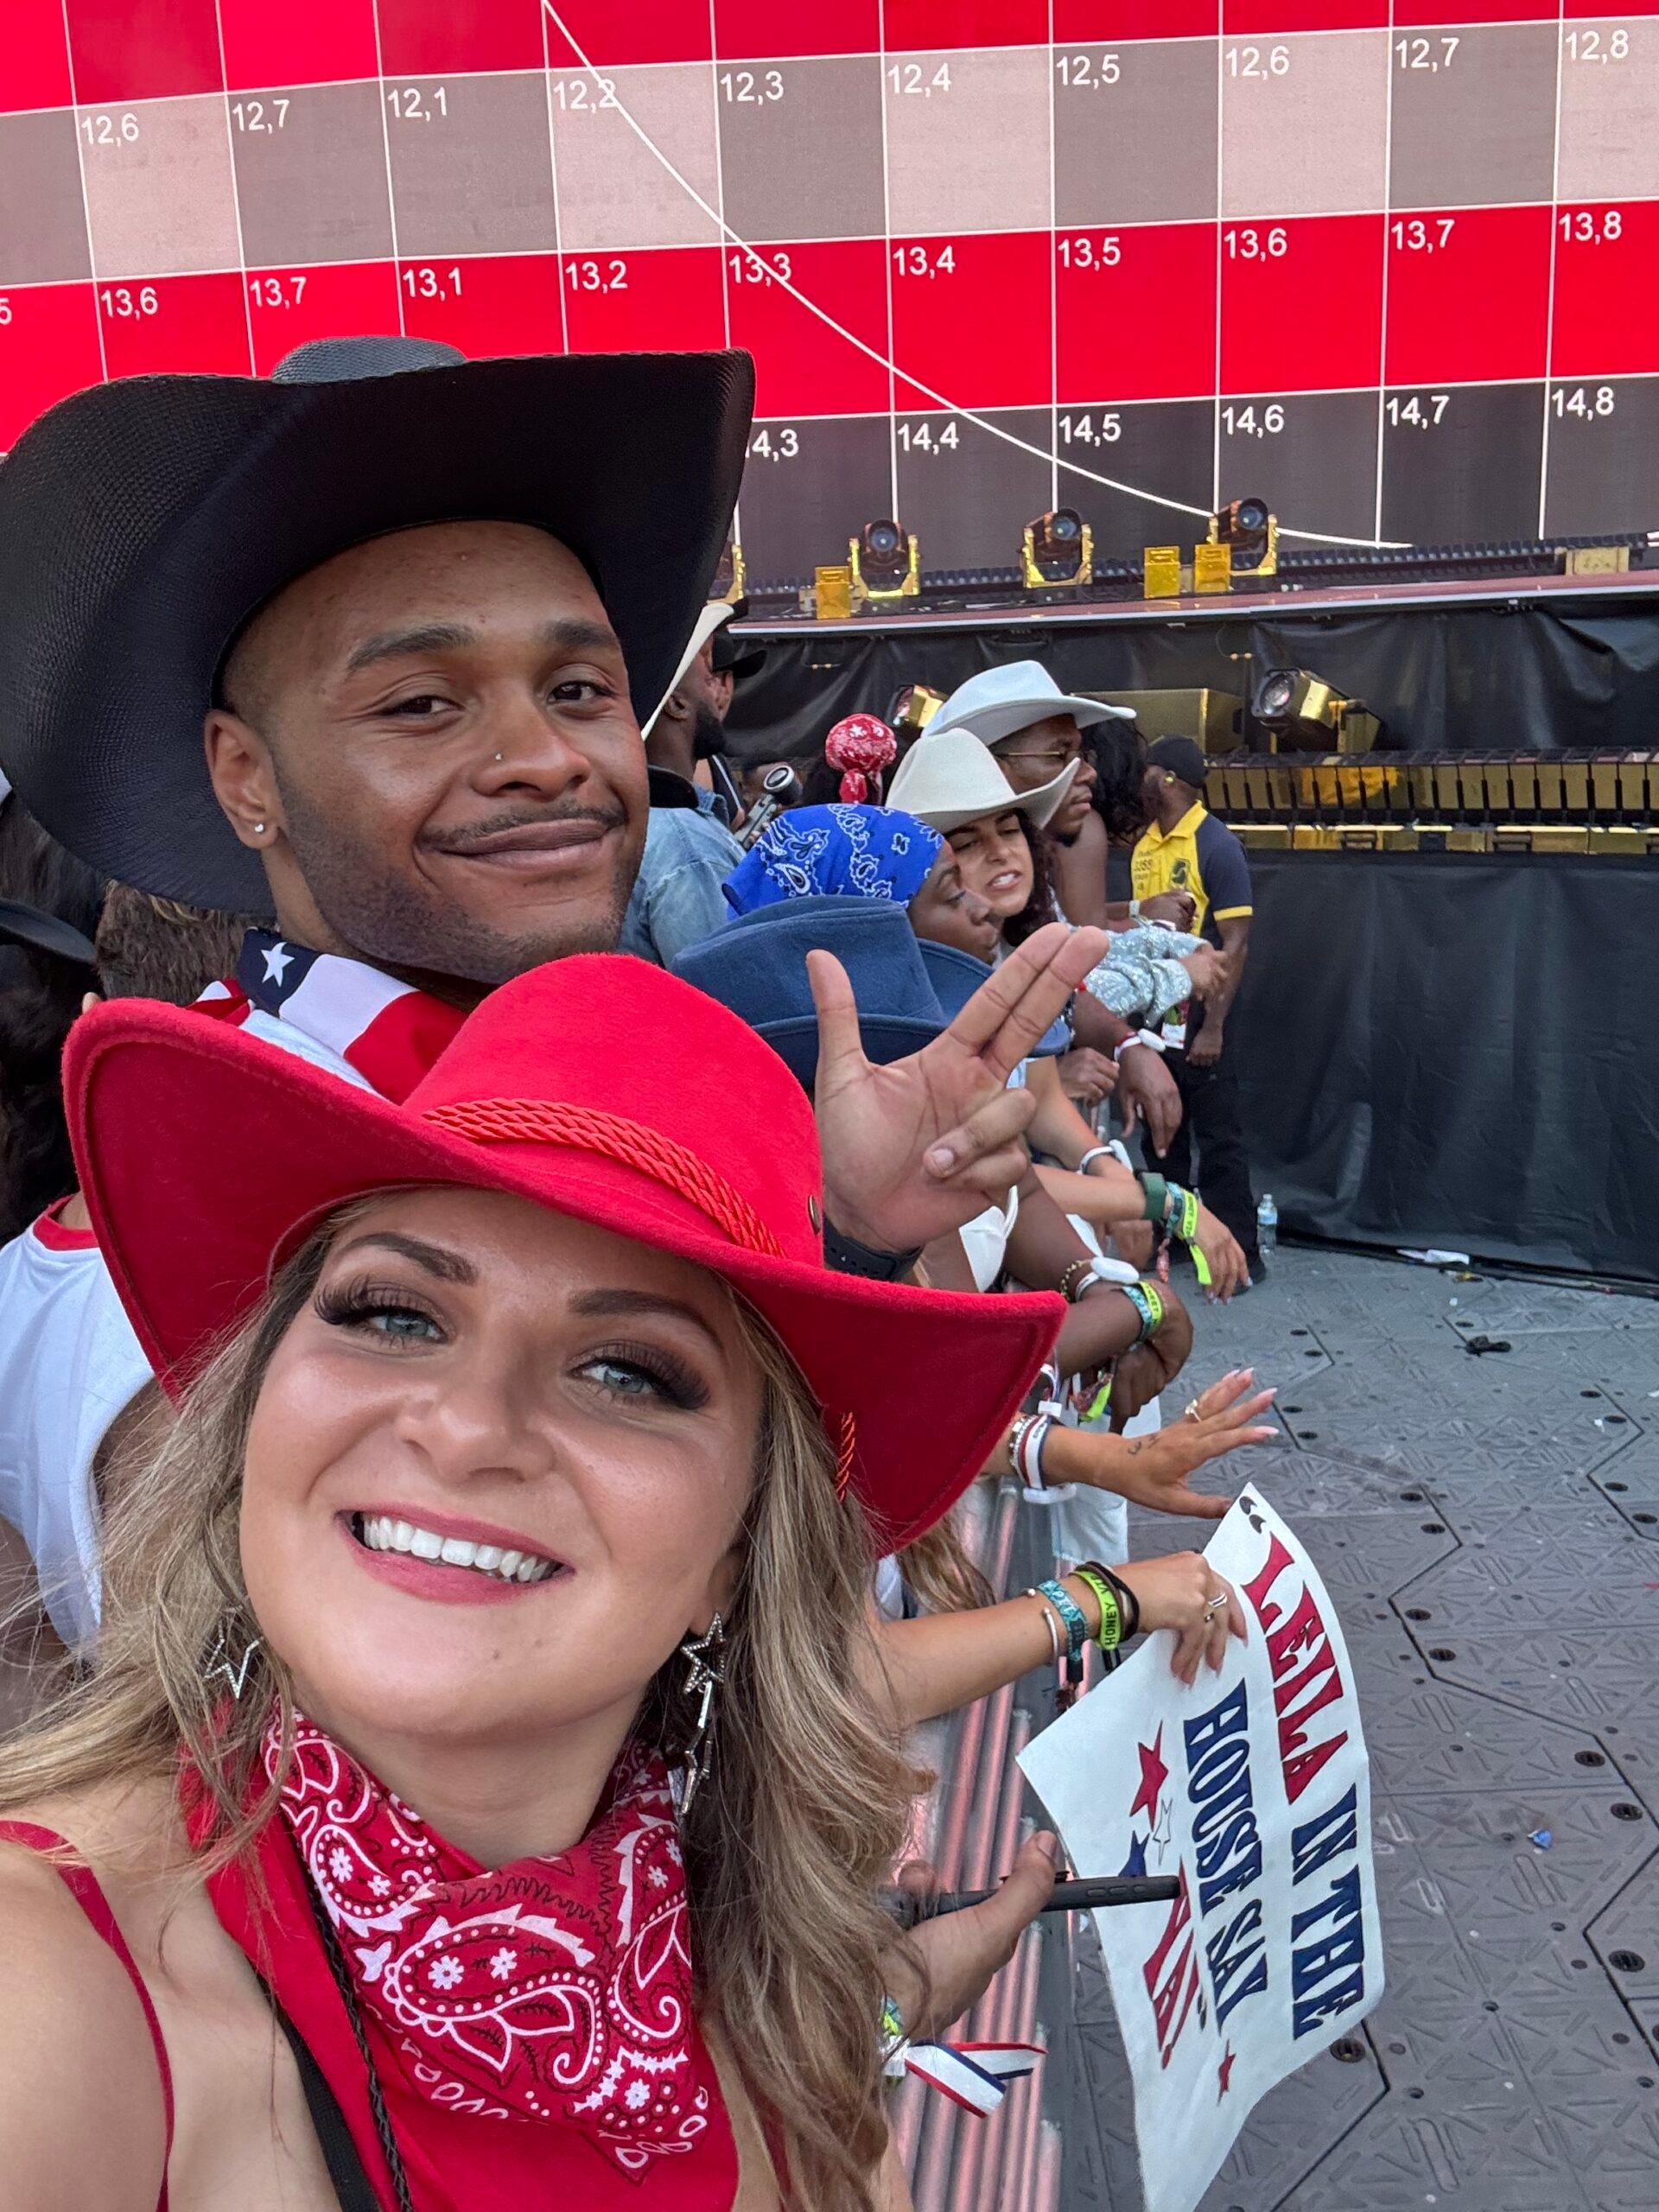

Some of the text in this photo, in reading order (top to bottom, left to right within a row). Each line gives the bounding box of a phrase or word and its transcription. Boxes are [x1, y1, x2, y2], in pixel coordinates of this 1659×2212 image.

[1226, 46, 1288, 79] 12,6
[1396, 38, 1459, 71] 12,7
[1566, 29, 1628, 63] 12,8
[721, 71, 784, 104] 12,3
[888, 63, 950, 97] 12,4
[1057, 54, 1120, 88] 12,5
[388, 87, 447, 121] 12,1
[554, 79, 614, 111] 12,2
[82, 113, 138, 145] 12,6
[233, 99, 289, 133] 12,7
[1224, 228, 1287, 262] 13,6
[1391, 219, 1455, 254] 13,7
[1559, 212, 1622, 245] 13,8
[729, 253, 791, 285] 13,3
[893, 245, 956, 278] 13,4
[1058, 237, 1121, 270] 13,5
[250, 276, 307, 309] 13,7
[403, 267, 461, 299] 13,1
[565, 260, 628, 292] 13,2
[100, 288, 158, 320] 13,6
[1386, 395, 1450, 429] 14,7
[1552, 386, 1614, 421] 14,8
[1059, 413, 1122, 446] 14,5
[1222, 404, 1284, 438] 14,6
[898, 422, 959, 454] 14,4
[1104, 1602, 1116, 1645] HONEY
[1290, 1783, 1358, 1885] IN
[1182, 1677, 1268, 2036] HOUSE SAY
[1291, 1865, 1365, 2040] THE
